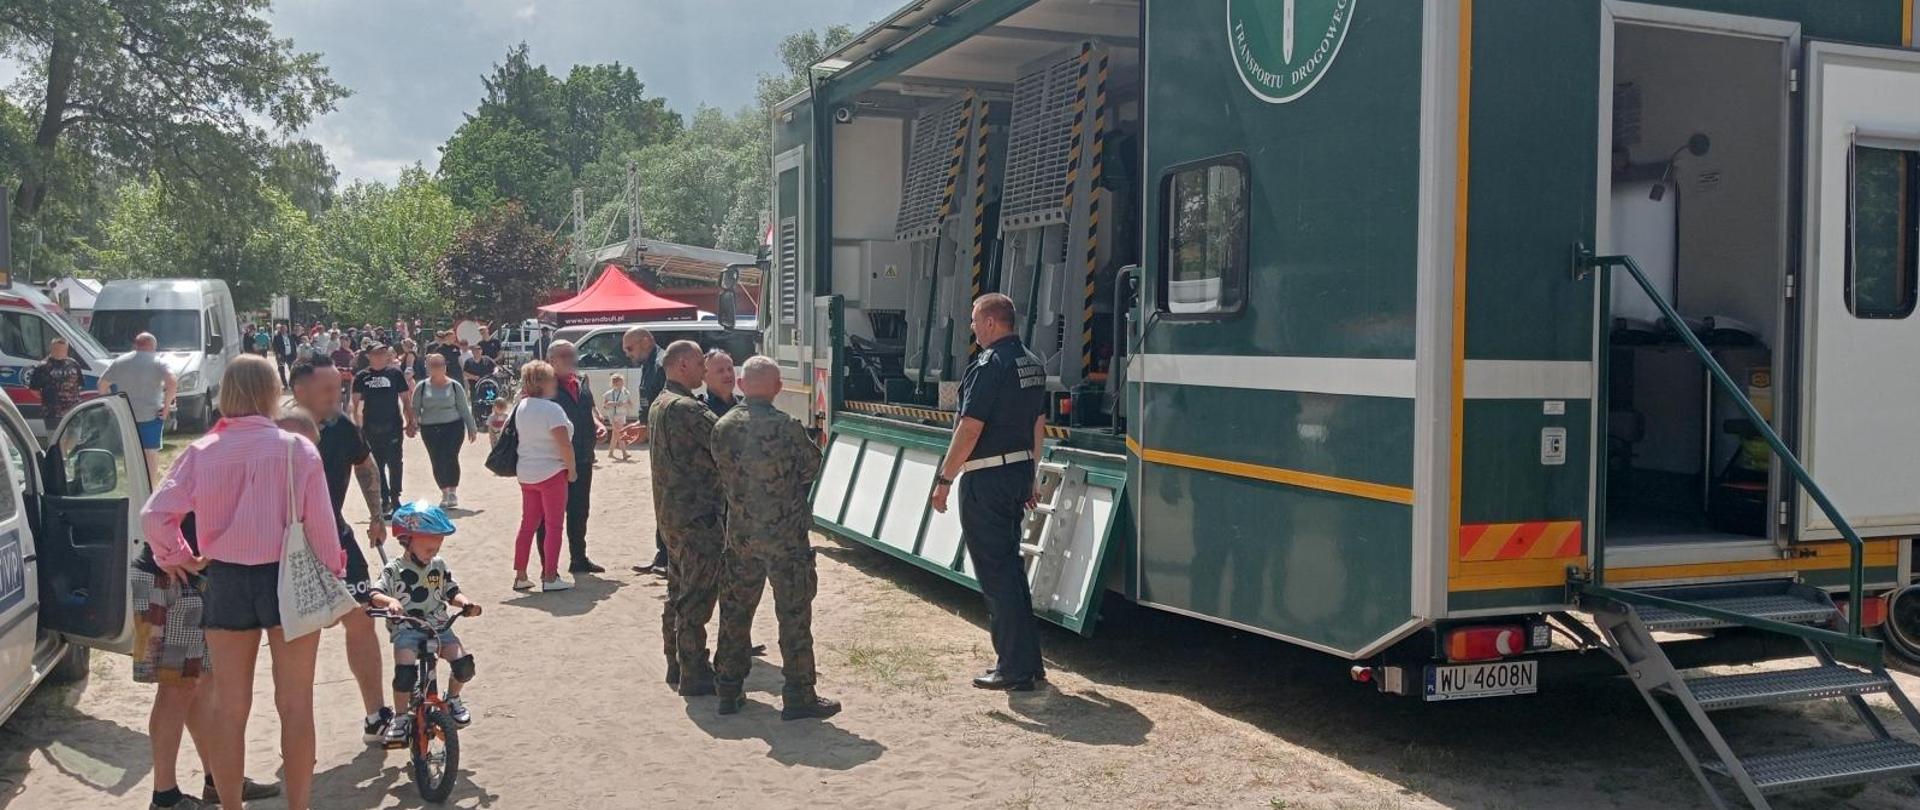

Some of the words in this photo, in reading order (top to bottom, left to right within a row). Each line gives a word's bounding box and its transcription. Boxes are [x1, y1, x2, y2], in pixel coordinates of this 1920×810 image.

[1235, 19, 1284, 89] TRANSPORTU
[1441, 668, 1466, 692] WU
[1474, 663, 1533, 690] 4608N
